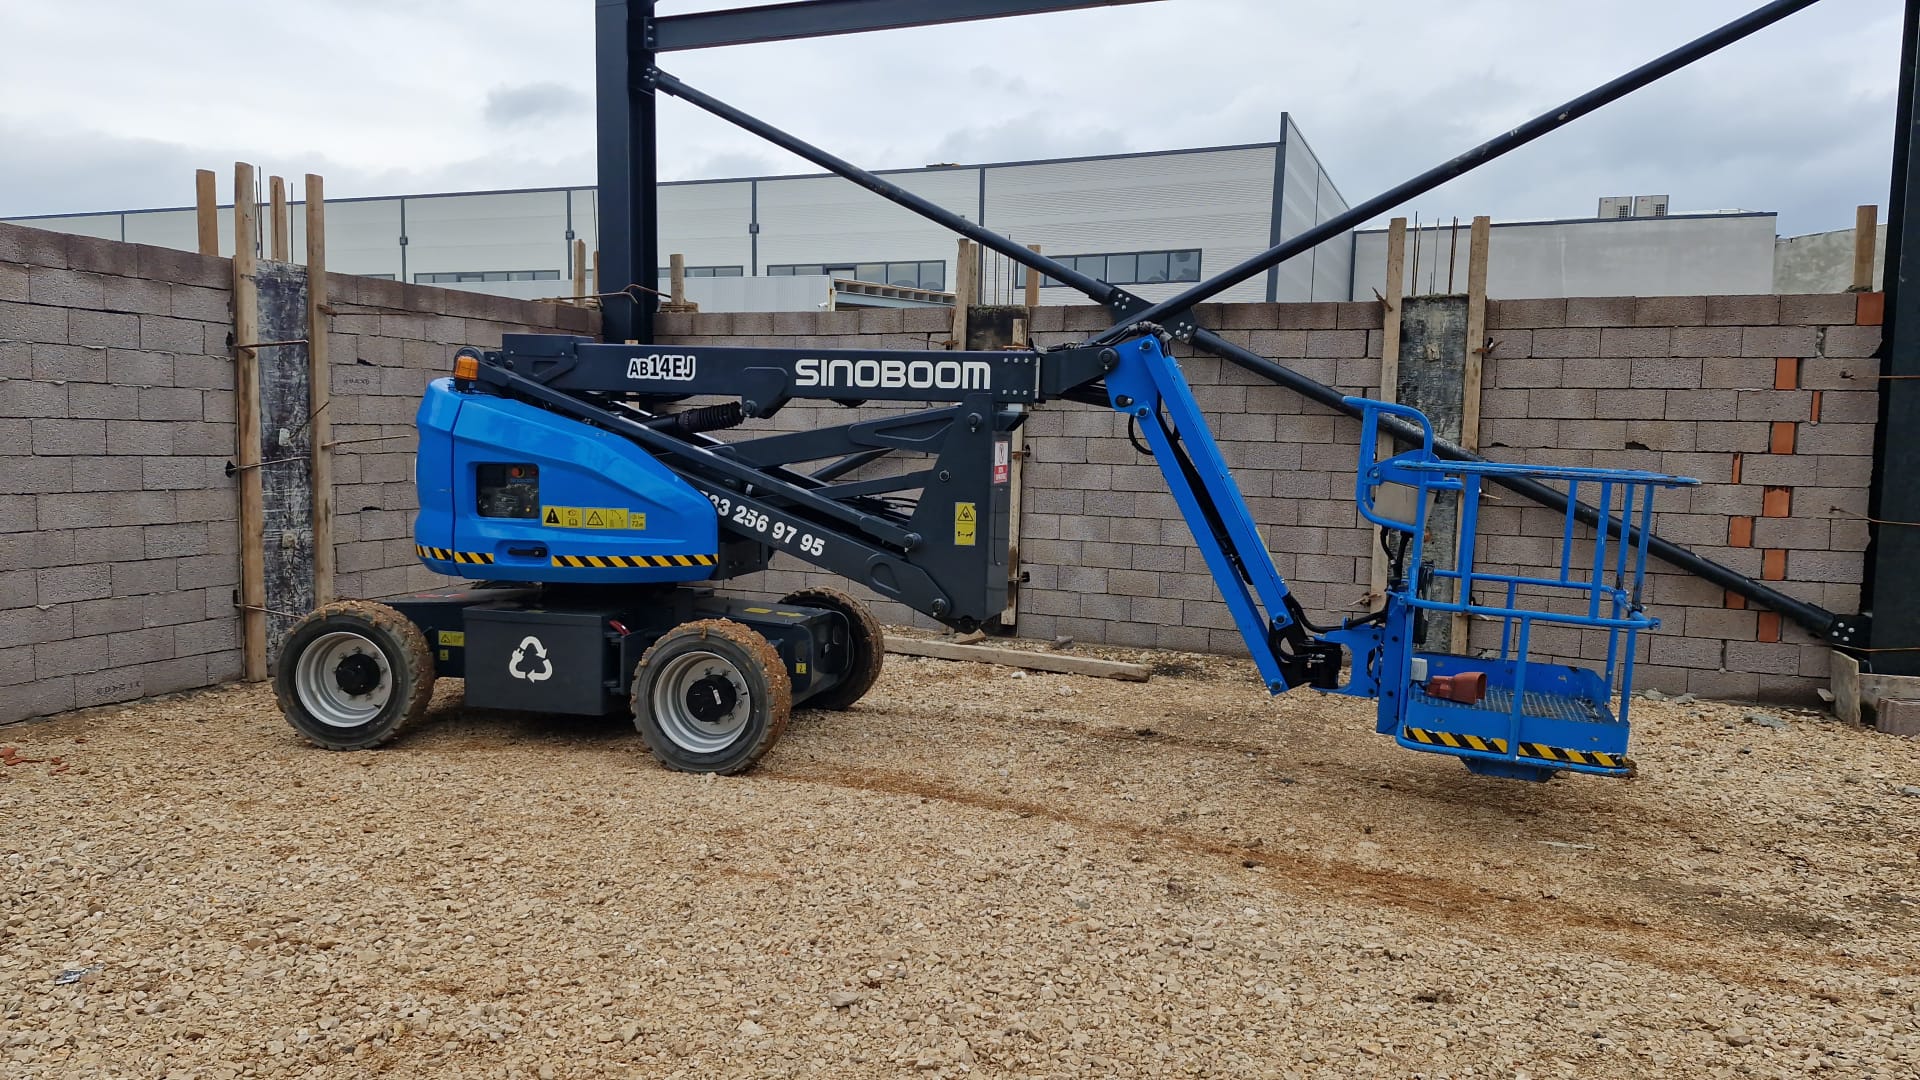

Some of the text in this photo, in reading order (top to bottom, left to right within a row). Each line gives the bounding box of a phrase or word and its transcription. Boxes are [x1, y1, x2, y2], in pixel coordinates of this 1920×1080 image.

[627, 355, 696, 381] AB14EJ
[795, 359, 991, 390] SINOBOOM
[732, 505, 769, 533] 256
[772, 522, 798, 544] 97
[800, 533, 825, 556] 95
